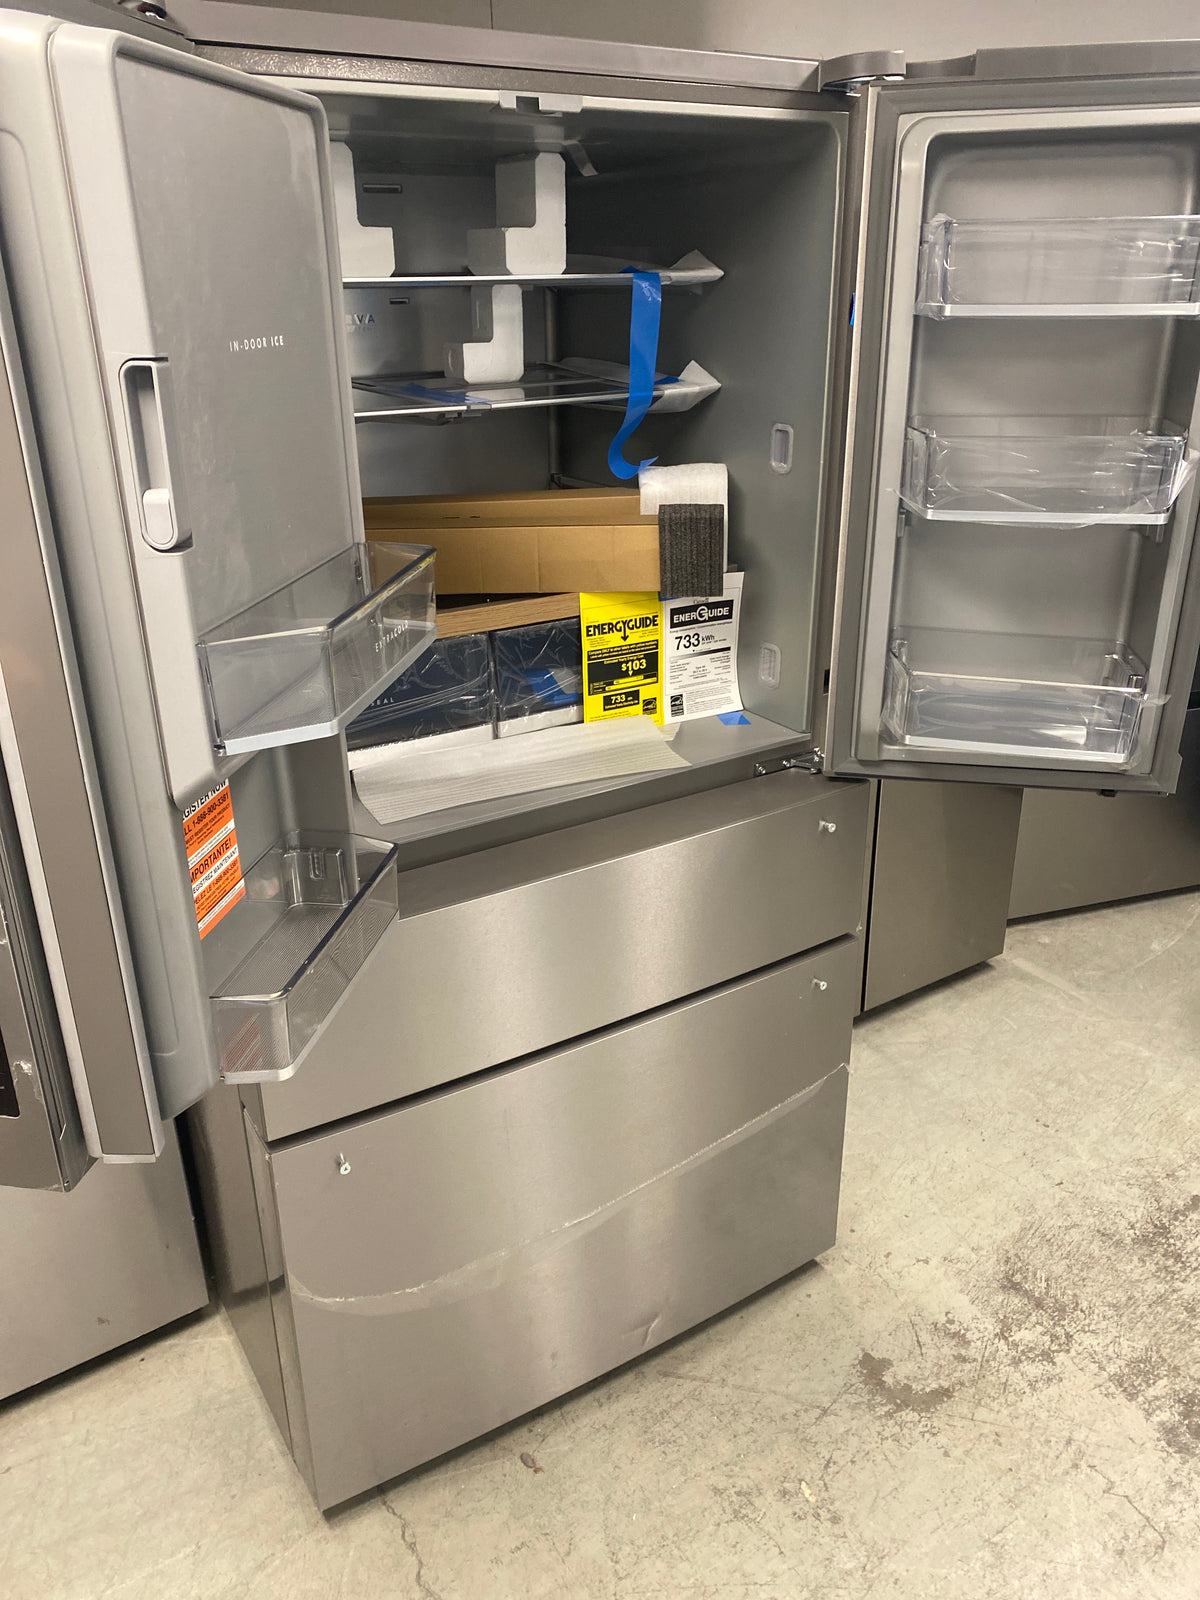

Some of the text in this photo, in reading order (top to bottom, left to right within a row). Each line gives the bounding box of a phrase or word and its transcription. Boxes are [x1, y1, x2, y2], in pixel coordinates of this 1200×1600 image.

[229, 335, 284, 352] IN-DOOR ICE
[673, 605, 730, 624] ENERGUIDE
[375, 620, 409, 653] EXTRACOLD
[586, 615, 659, 639] ENERGYGUIDE
[674, 632, 700, 651] 733
[701, 634, 715, 642] kWh
[621, 659, 647, 671] $103
[611, 695, 626, 704] 733
